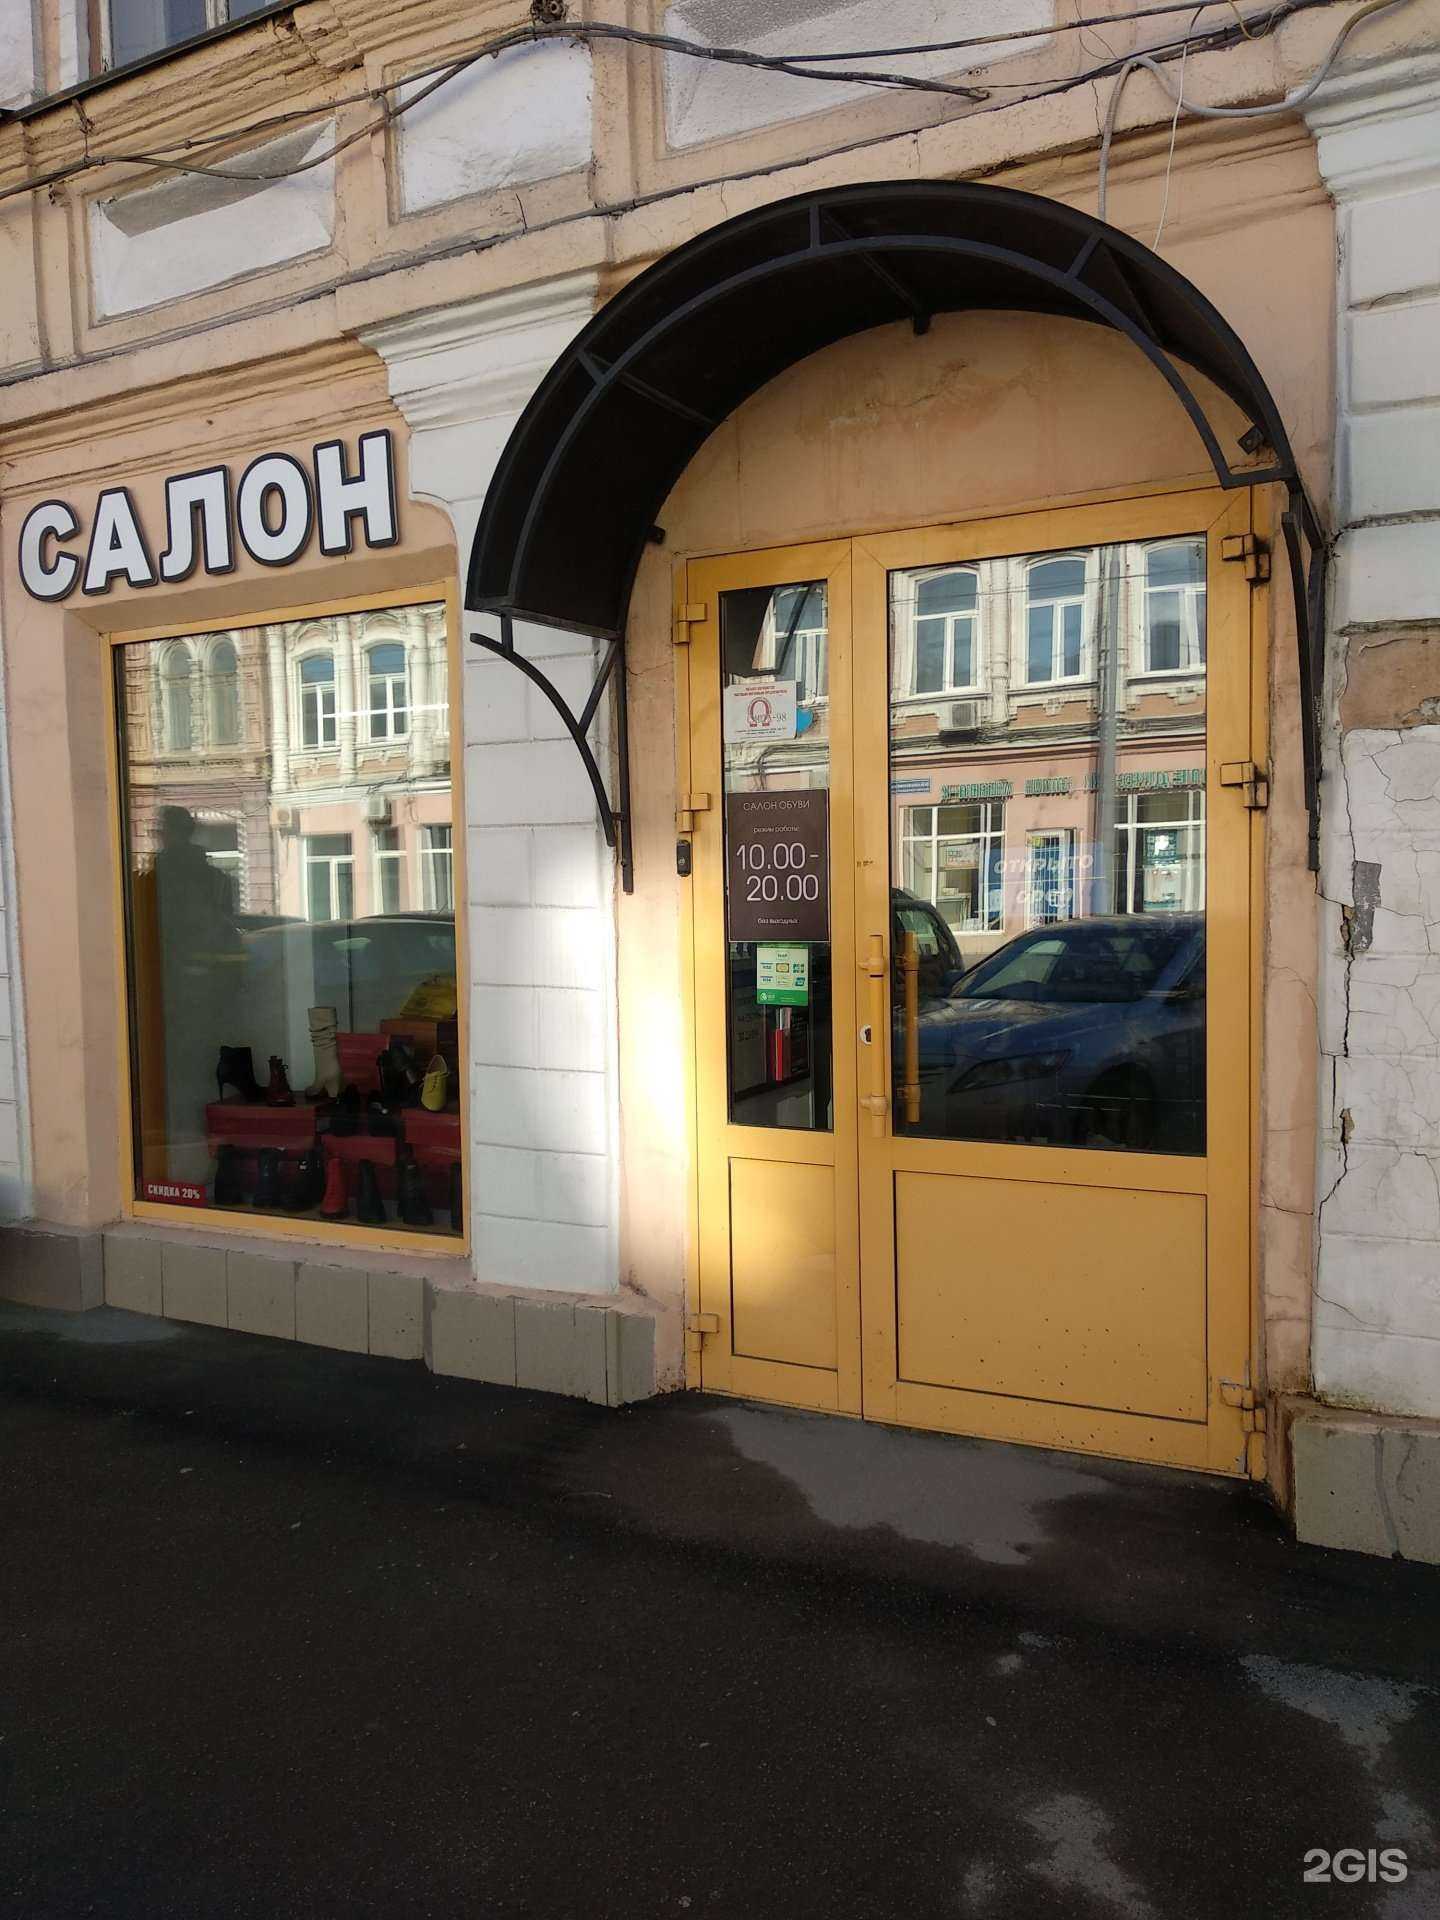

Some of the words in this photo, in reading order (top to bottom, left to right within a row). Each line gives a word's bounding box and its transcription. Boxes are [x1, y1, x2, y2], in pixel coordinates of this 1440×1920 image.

[19, 428, 398, 601] САЛОН
[743, 802, 777, 811] САЛОН
[779, 800, 810, 809] ОБУВИ
[746, 874, 819, 902] 20.00
[148, 1184, 180, 1197] СКИДКА
[182, 1187, 201, 1200] 20%
